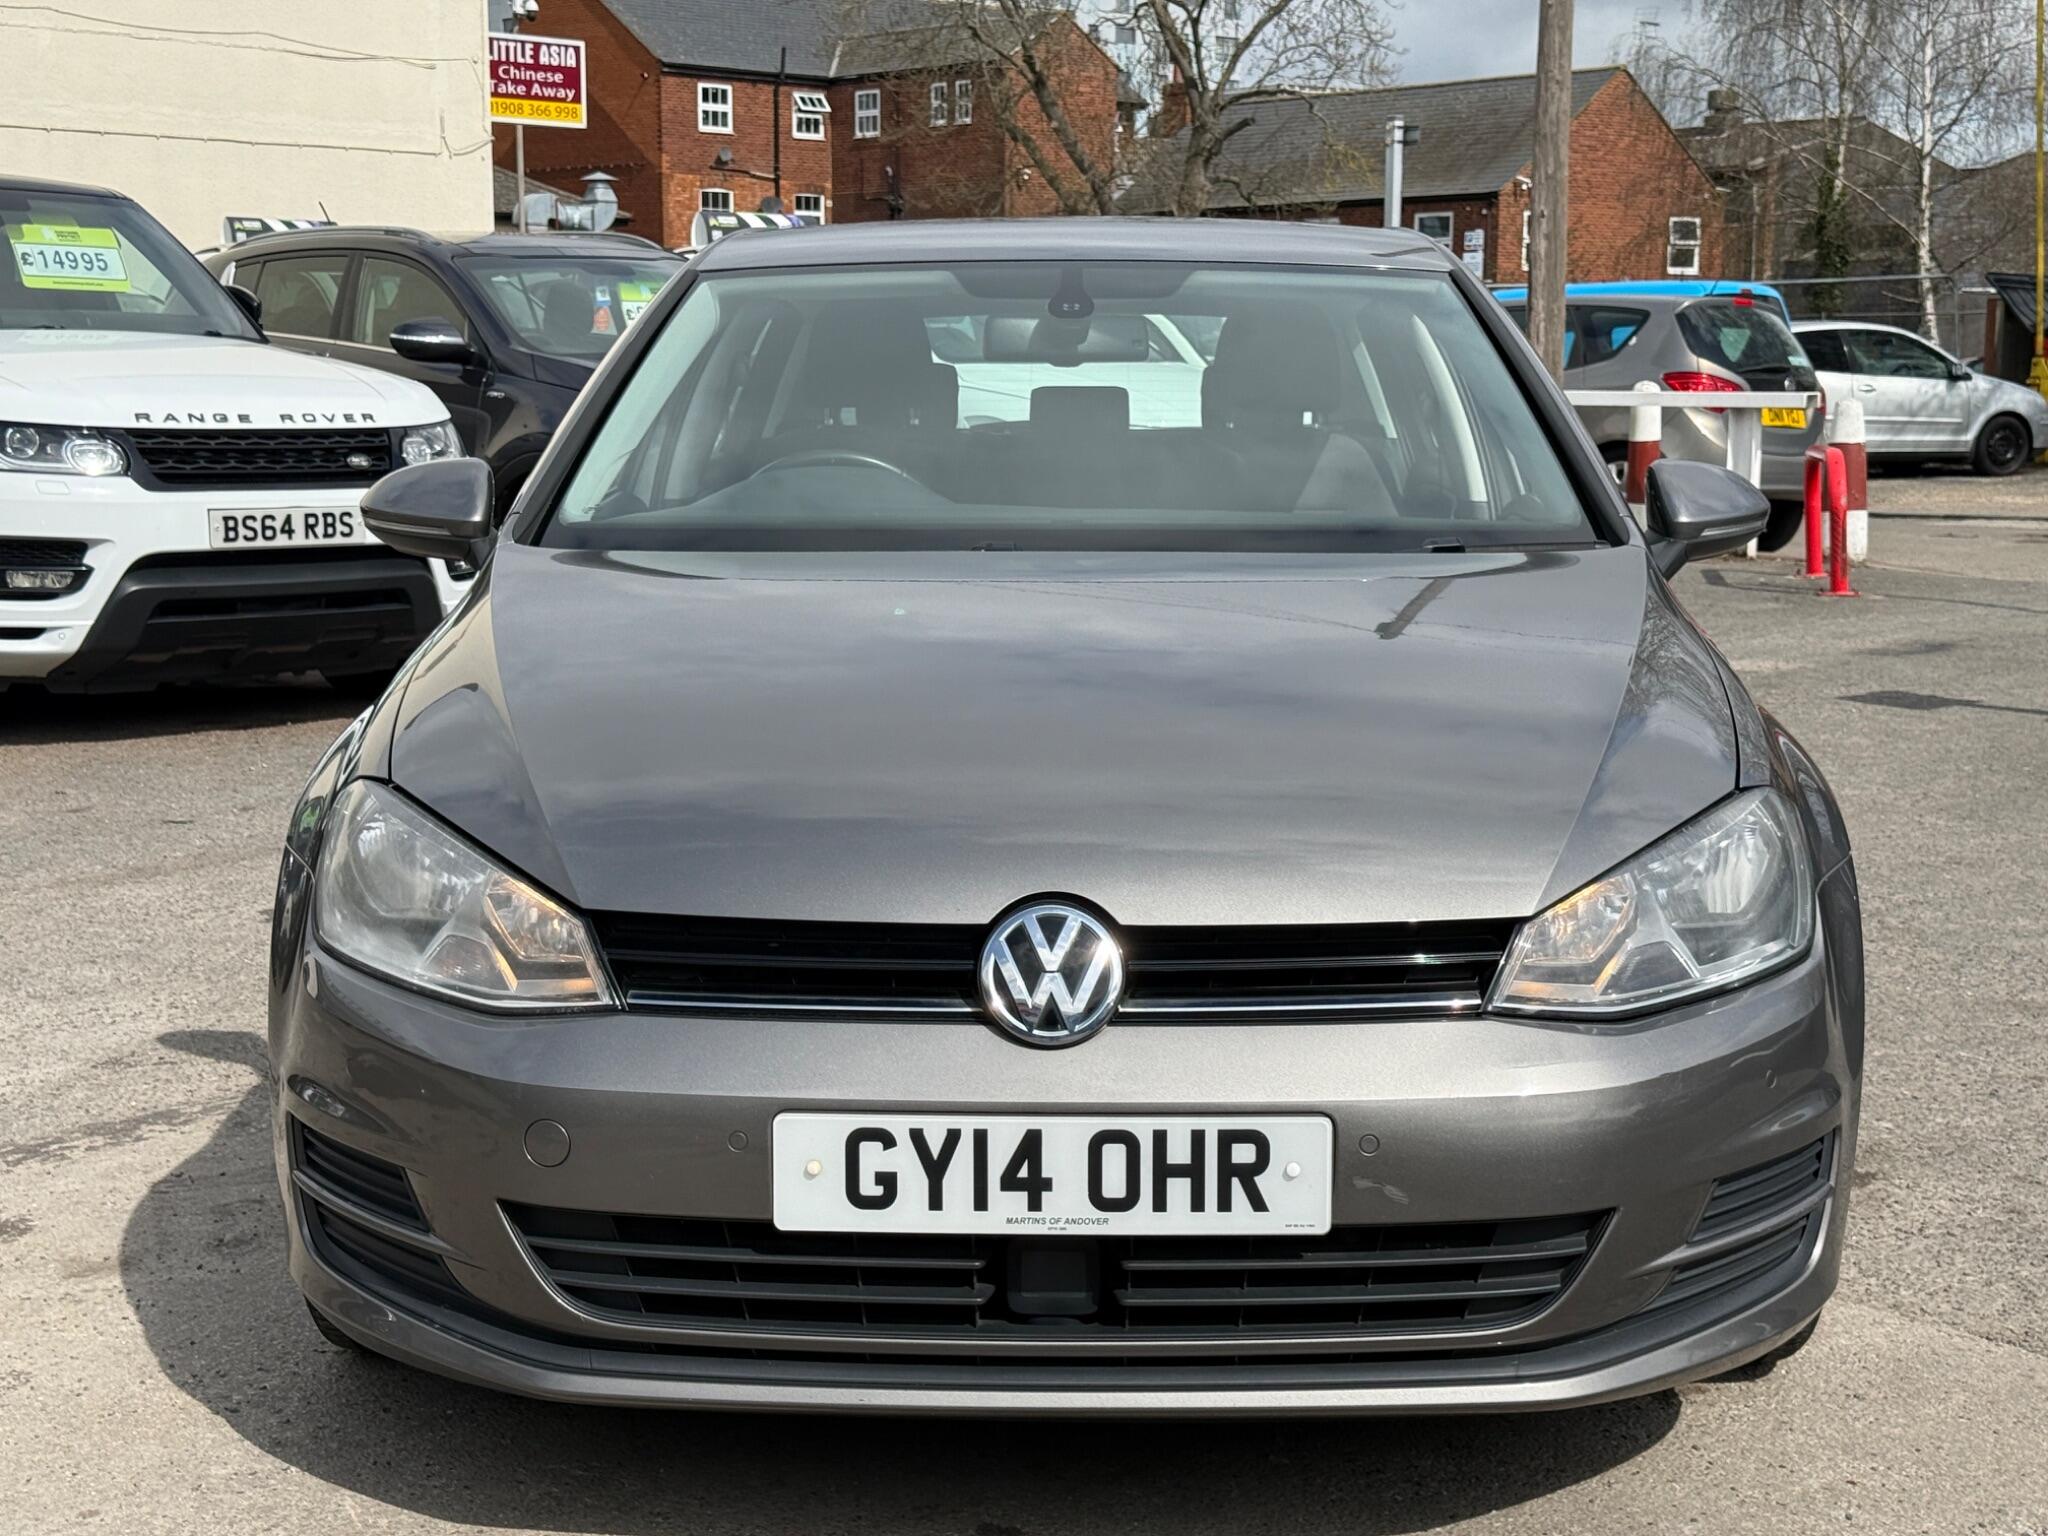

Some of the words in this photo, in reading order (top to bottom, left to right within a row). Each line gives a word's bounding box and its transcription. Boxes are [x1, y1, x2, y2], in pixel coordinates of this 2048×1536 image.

[539, 44, 577, 67] ASIA
[498, 63, 564, 83] Chinese
[530, 83, 576, 102] Away
[527, 103, 552, 117] 366
[554, 105, 578, 119] 998
[134, 412, 253, 424] RANGE
[279, 412, 377, 424] ROVER
[222, 513, 296, 543] BS64
[303, 511, 354, 540] RBS
[844, 1126, 1053, 1213] GY14
[1087, 1128, 1271, 1214] OHR
[1005, 1216, 1047, 1226] MARTINS
[1048, 1217, 1063, 1226] OF
[1063, 1217, 1110, 1226] ANDOVER
